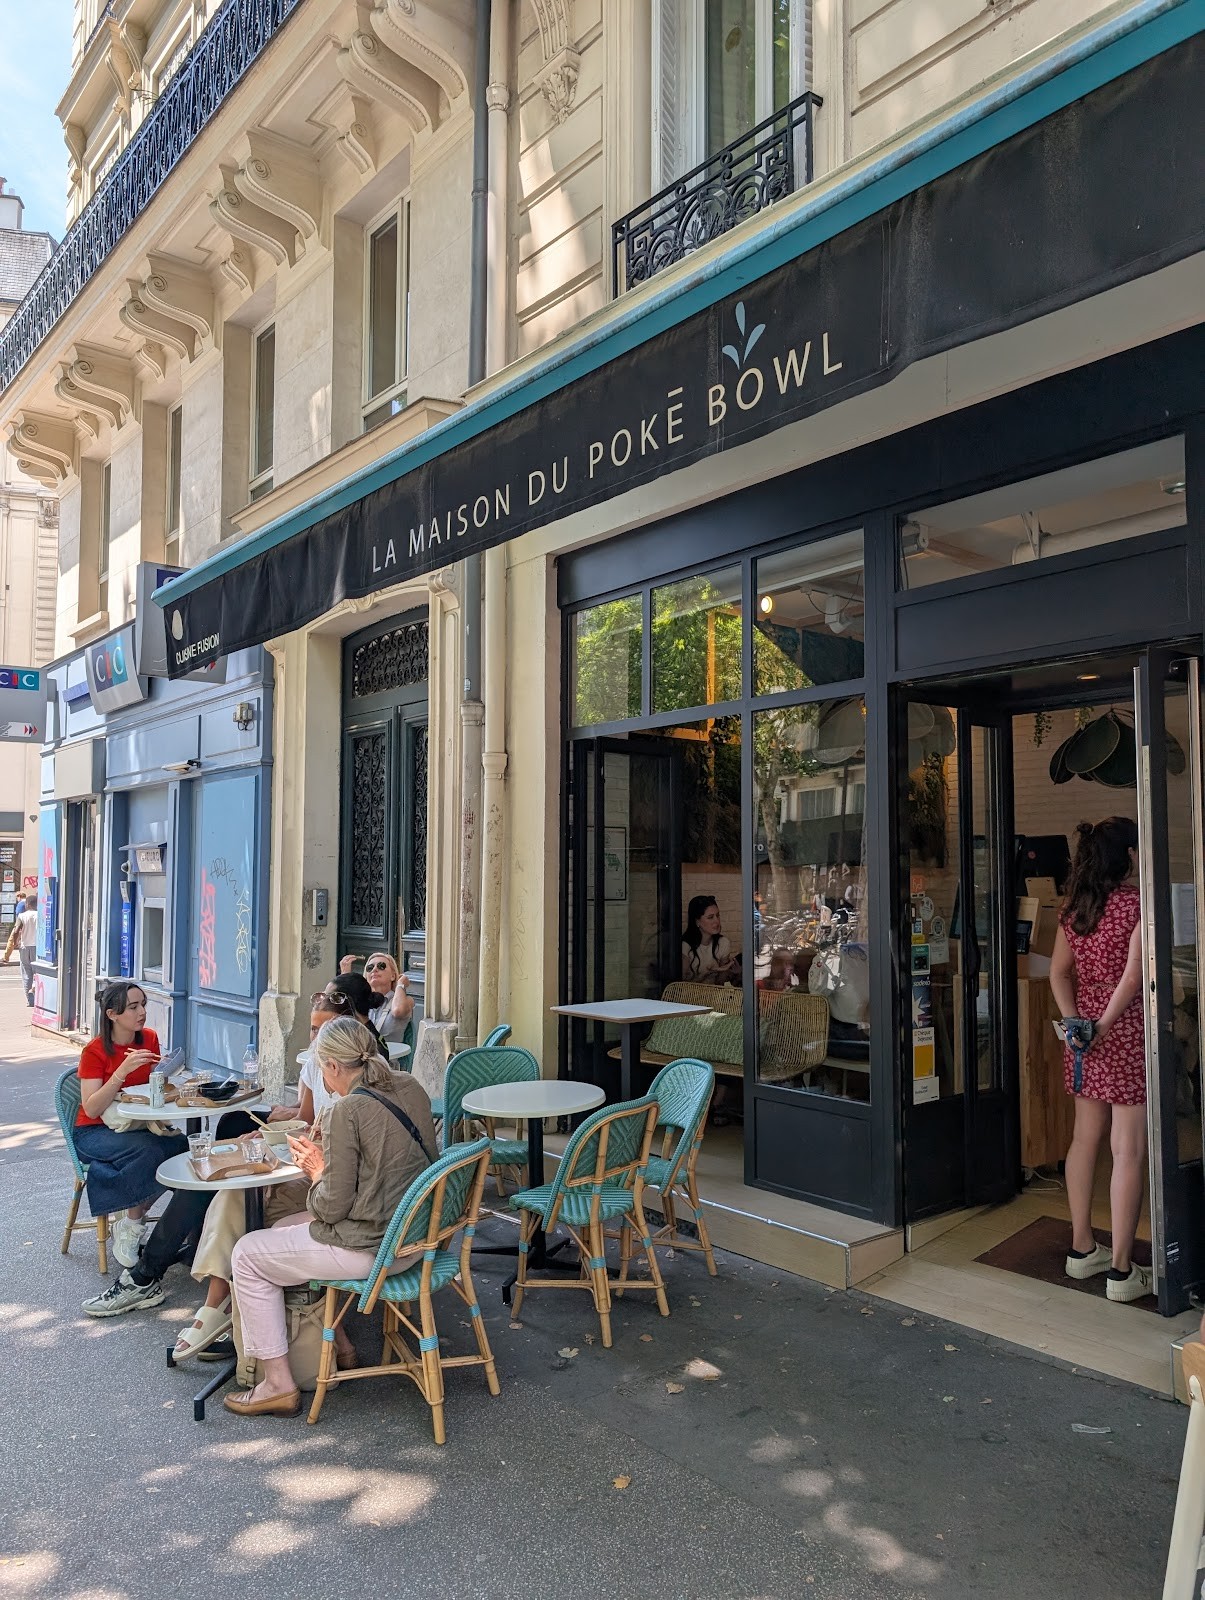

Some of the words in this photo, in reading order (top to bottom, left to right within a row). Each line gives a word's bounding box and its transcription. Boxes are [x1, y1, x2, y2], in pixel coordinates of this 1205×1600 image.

[372, 538, 397, 573] LA
[408, 483, 511, 558] MAISON
[527, 456, 569, 506] DU
[707, 332, 843, 426] BOWL
[197, 632, 220, 654] FUSION
[0, 671, 35, 687] CIC
[96, 646, 124, 683] CIC
